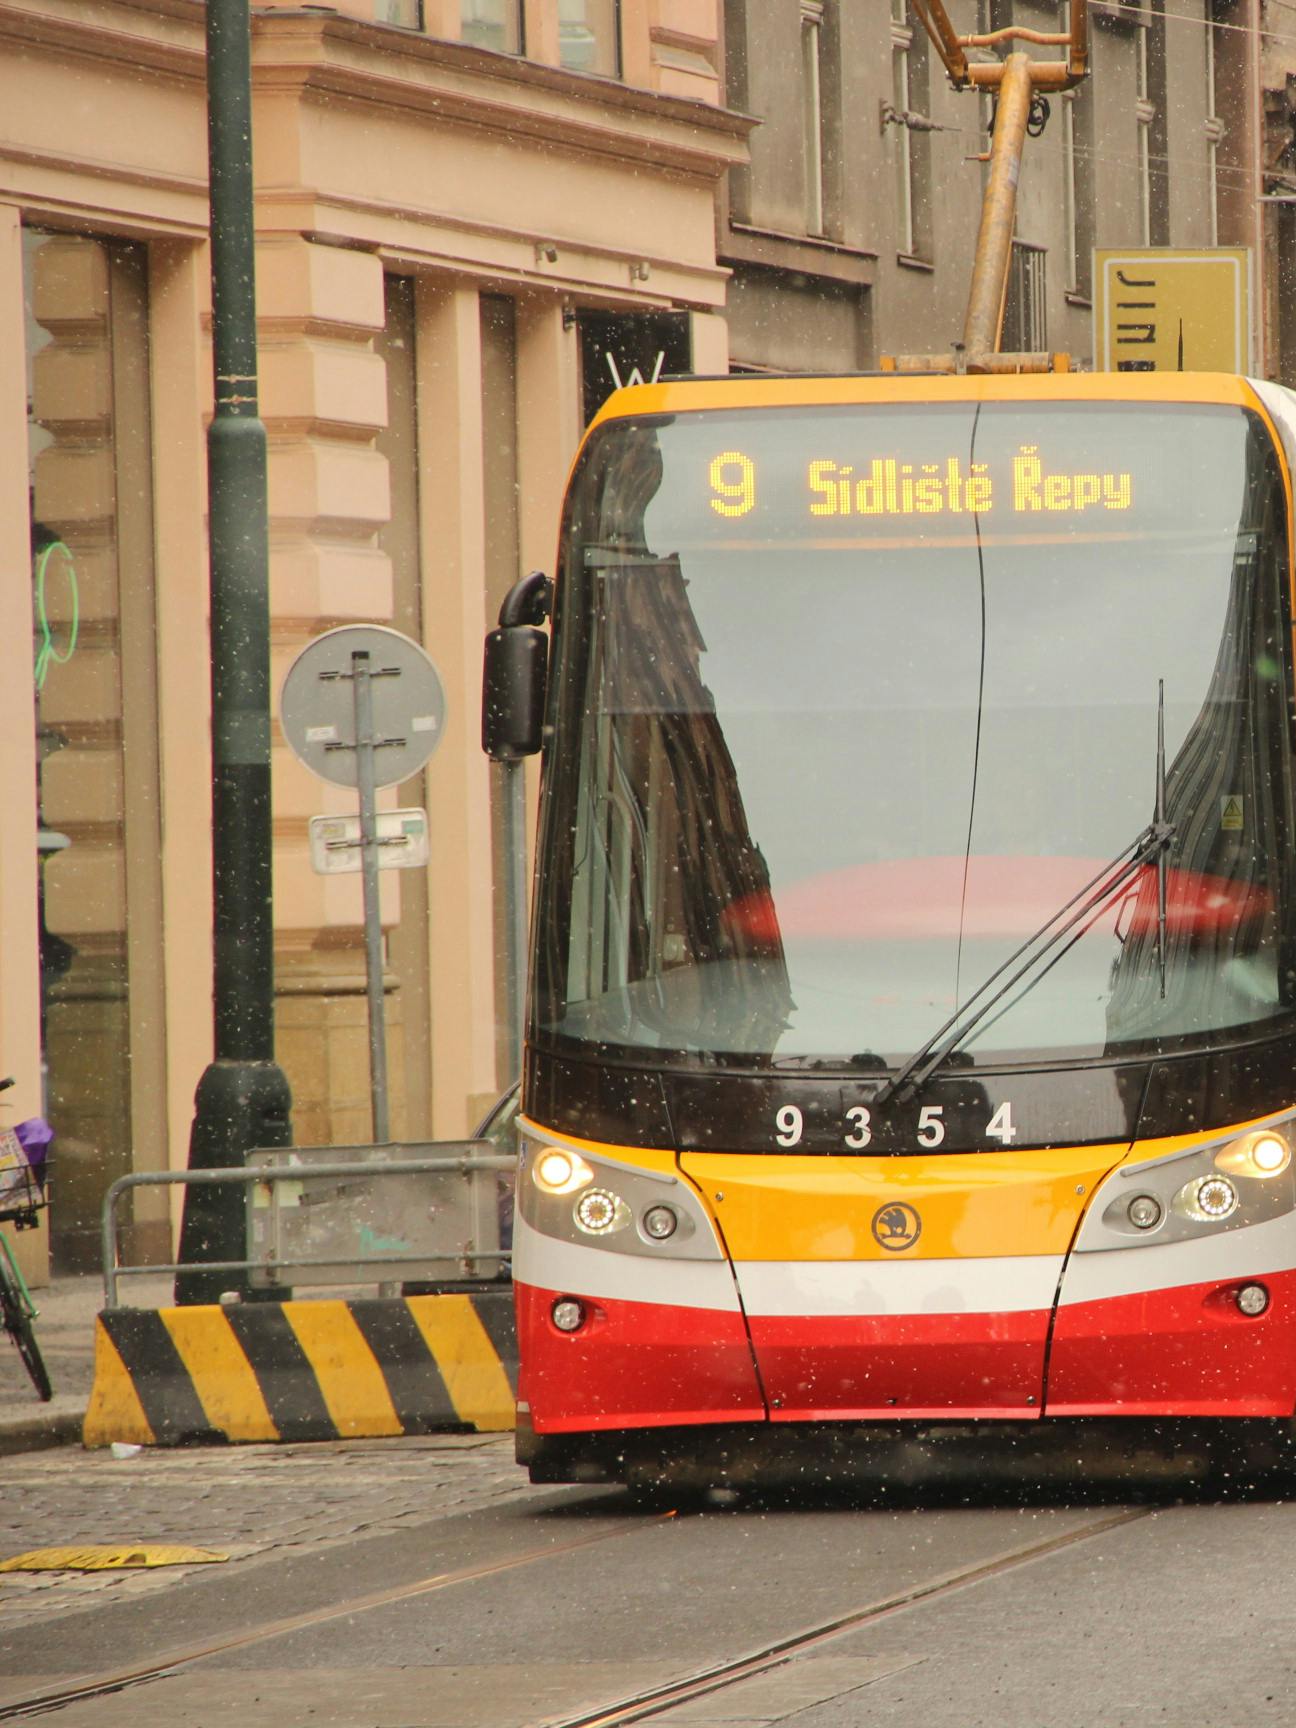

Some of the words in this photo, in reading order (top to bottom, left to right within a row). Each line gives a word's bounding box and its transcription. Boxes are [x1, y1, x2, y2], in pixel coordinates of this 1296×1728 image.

[710, 451, 755, 517] 9
[808, 457, 993, 516] Sídliště
[1011, 445, 1131, 512] Řepy
[775, 1101, 1017, 1149] 9354
